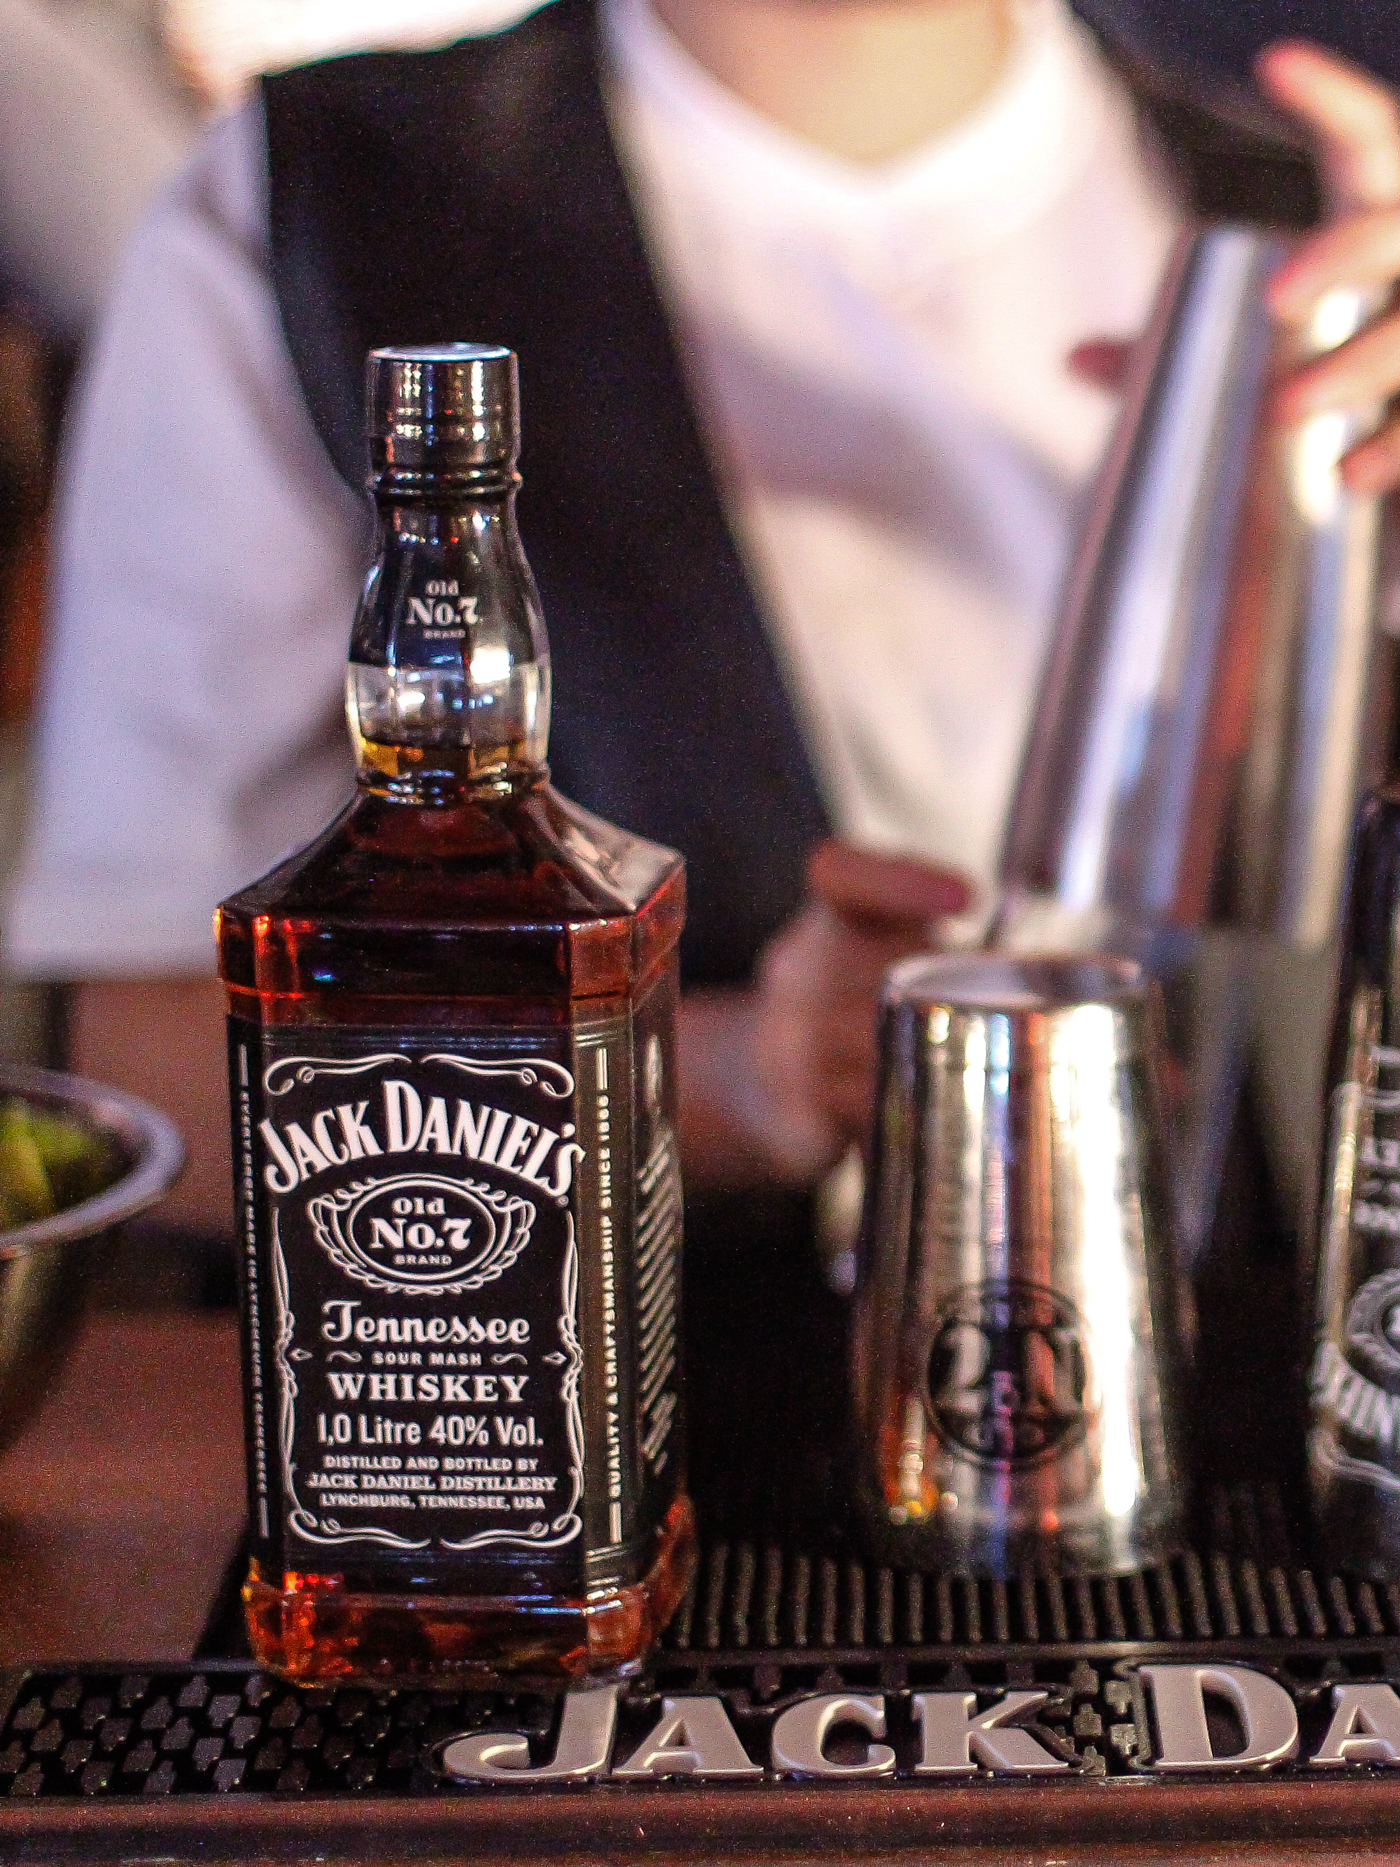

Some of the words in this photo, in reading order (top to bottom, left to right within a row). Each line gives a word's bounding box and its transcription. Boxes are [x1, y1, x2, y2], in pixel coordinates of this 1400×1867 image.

[425, 580, 459, 596] Old
[405, 596, 479, 626] No.7
[257, 1100, 384, 1194] JACK
[381, 1080, 587, 1198] DANIEL'S
[598, 1147, 612, 1209] SINCE
[391, 1197, 446, 1216] Old
[368, 1218, 473, 1250] No.7
[392, 1254, 452, 1266] BRAND
[600, 1215, 618, 1389] CRAFTSMANSHIP
[321, 1300, 531, 1345] Tennessee
[371, 1352, 422, 1366] SOUR
[428, 1352, 482, 1366] MASH
[325, 1372, 530, 1403] WHISKEY
[317, 1412, 351, 1447] 1,0
[358, 1413, 422, 1445] Litre
[428, 1414, 490, 1446] 40%
[493, 1416, 545, 1447] Vol.
[323, 1455, 402, 1470] DISTILLED
[405, 1456, 440, 1470] AND
[442, 1457, 513, 1472] BOTTLED
[515, 1458, 539, 1472] BY
[606, 1411, 622, 1498] QUALITY
[307, 1472, 359, 1489] JACK
[360, 1473, 436, 1490] DANIEL
[438, 1475, 559, 1491] DISTILLERY
[319, 1493, 417, 1510] LYNCHBURG,
[513, 1496, 546, 1510] USA
[443, 1682, 1070, 1779] JACK
